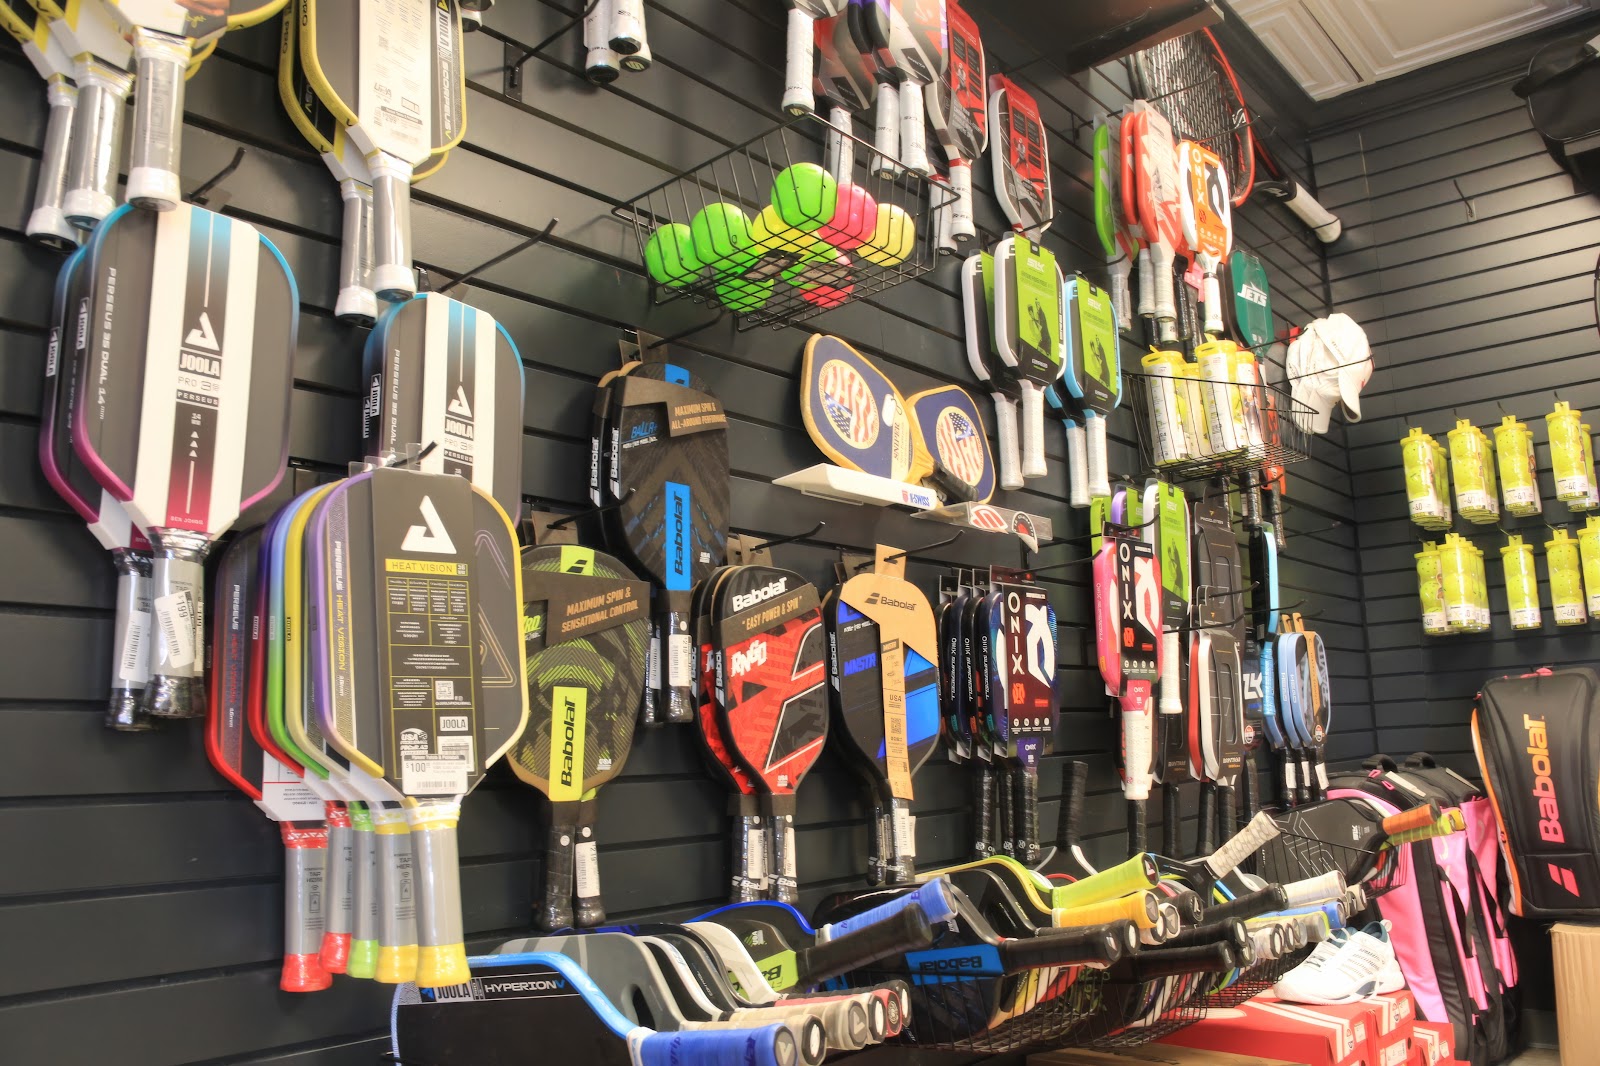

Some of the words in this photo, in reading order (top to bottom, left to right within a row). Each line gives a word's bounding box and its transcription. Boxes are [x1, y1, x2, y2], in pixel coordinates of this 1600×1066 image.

[103, 267, 117, 331] PERSEUS
[100, 351, 110, 385] DUAL
[180, 353, 220, 377] JOOLA
[392, 348, 401, 401] PERSEUS
[178, 376, 198, 388] PRO
[177, 391, 219, 406] PERSEUS
[674, 404, 701, 417] MAXIMUM
[445, 418, 474, 439] JOOLA
[444, 449, 474, 463] PERSEUS
[591, 437, 599, 487] Babolat
[674, 491, 684, 577] Babolat
[334, 540, 343, 592] PERSEUS
[392, 561, 418, 571] HEAT
[420, 563, 453, 573] VISION
[1119, 542, 1134, 621] ONIX
[231, 584, 241, 630] PERSEUS
[336, 594, 344, 624] HEAT
[566, 596, 605, 616] MAXIMUM
[605, 590, 624, 606] SPIN
[624, 586, 632, 598] &
[732, 577, 788, 612] Babolat
[880, 596, 917, 612] Babolat
[561, 609, 609, 633] SENSATIONAL
[609, 599, 639, 619] CONTROL
[746, 613, 763, 631] EASY
[761, 608, 781, 626] POWER
[787, 599, 799, 614] SPIN
[336, 626, 347, 672] VISION
[1008, 591, 1025, 675] ONIX
[831, 632, 839, 675] Babolat
[843, 652, 877, 677] MNSTR
[889, 694, 902, 703] USA
[441, 718, 467, 729] JOOLA
[561, 696, 577, 788] Babolat
[1523, 712, 1566, 844] Babolat
[437, 983, 472, 999] JOOLA
[484, 981, 556, 993] HYPERION
